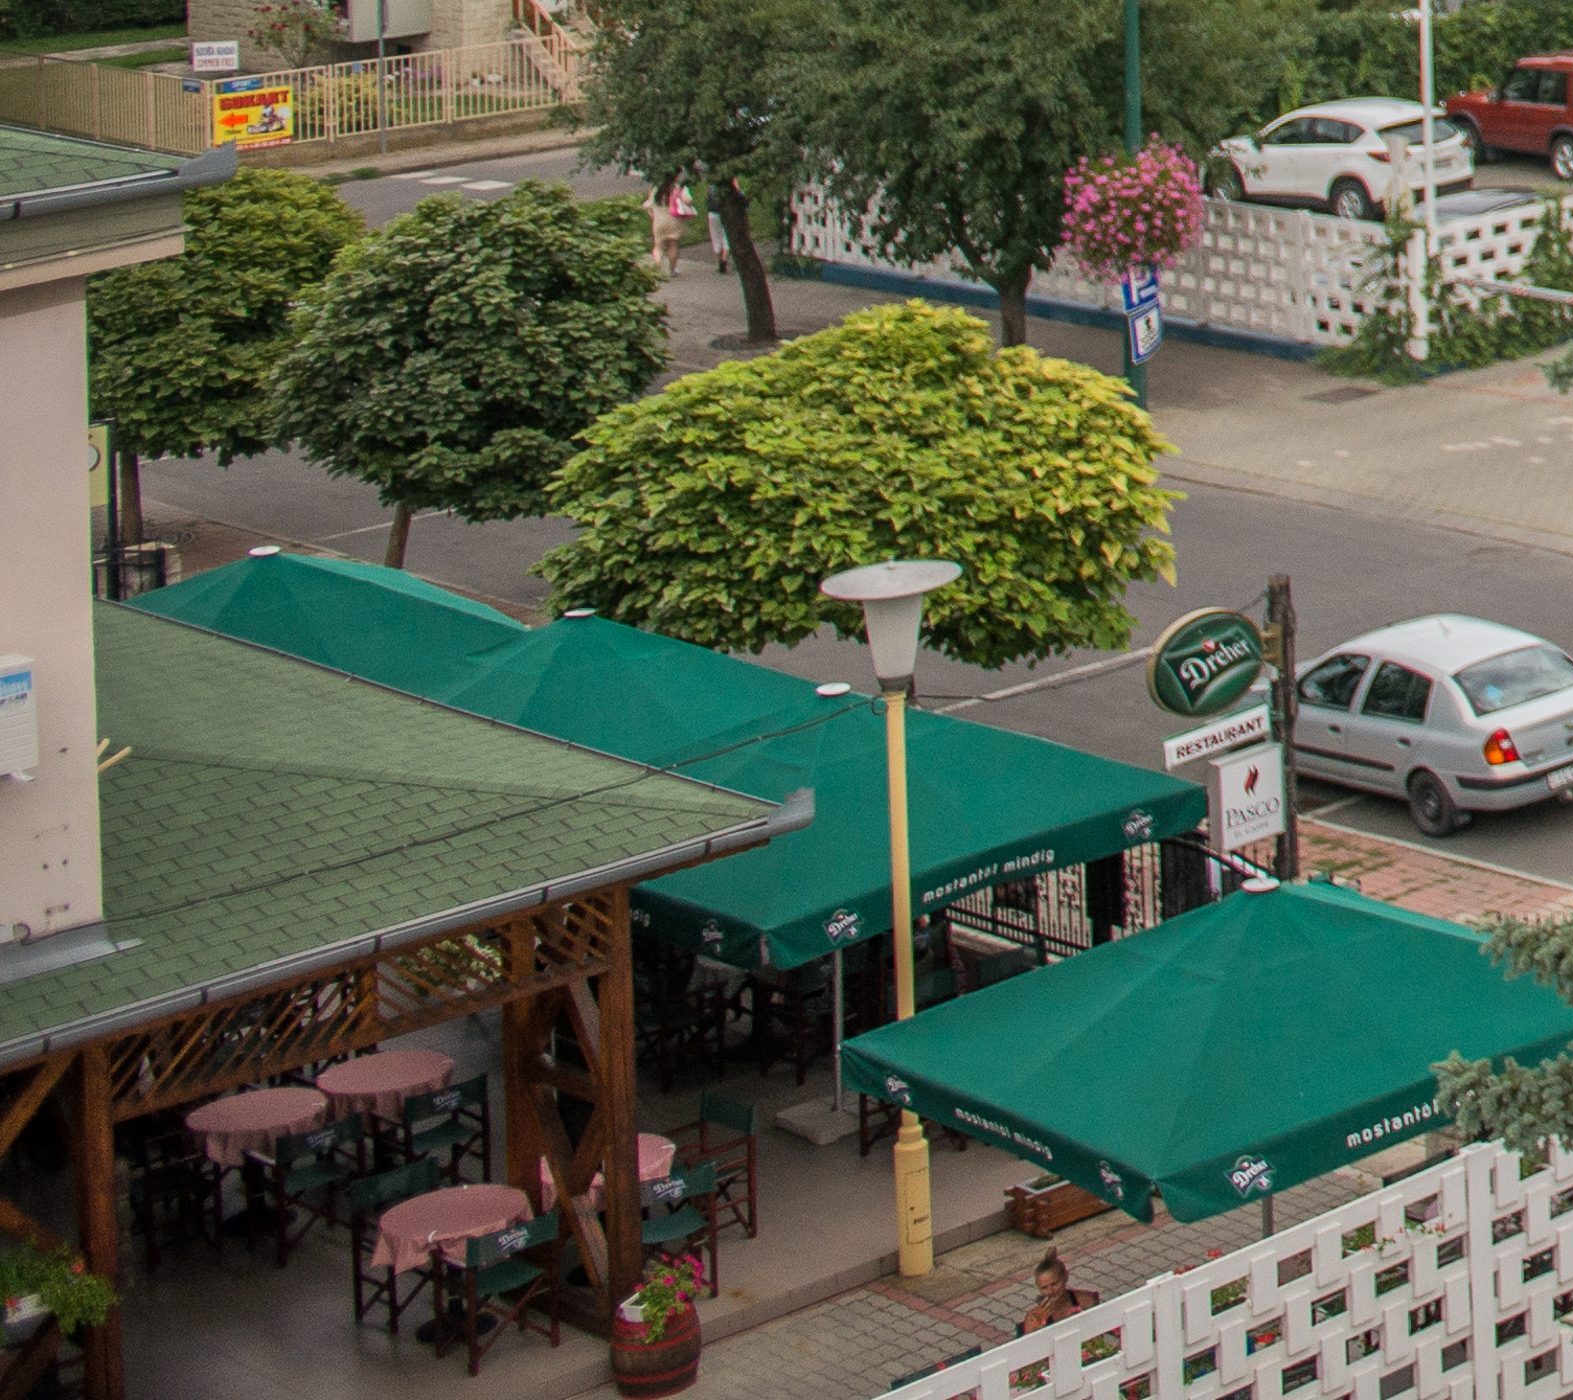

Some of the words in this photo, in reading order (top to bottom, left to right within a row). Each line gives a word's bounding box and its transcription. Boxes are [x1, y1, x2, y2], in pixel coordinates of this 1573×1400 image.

[1179, 638, 1252, 690] Dreher
[1175, 715, 1264, 760] RESTAURANT
[1225, 798, 1280, 829] PASCO
[1003, 849, 1056, 874] mindig
[1346, 1098, 1439, 1148] mostantól
